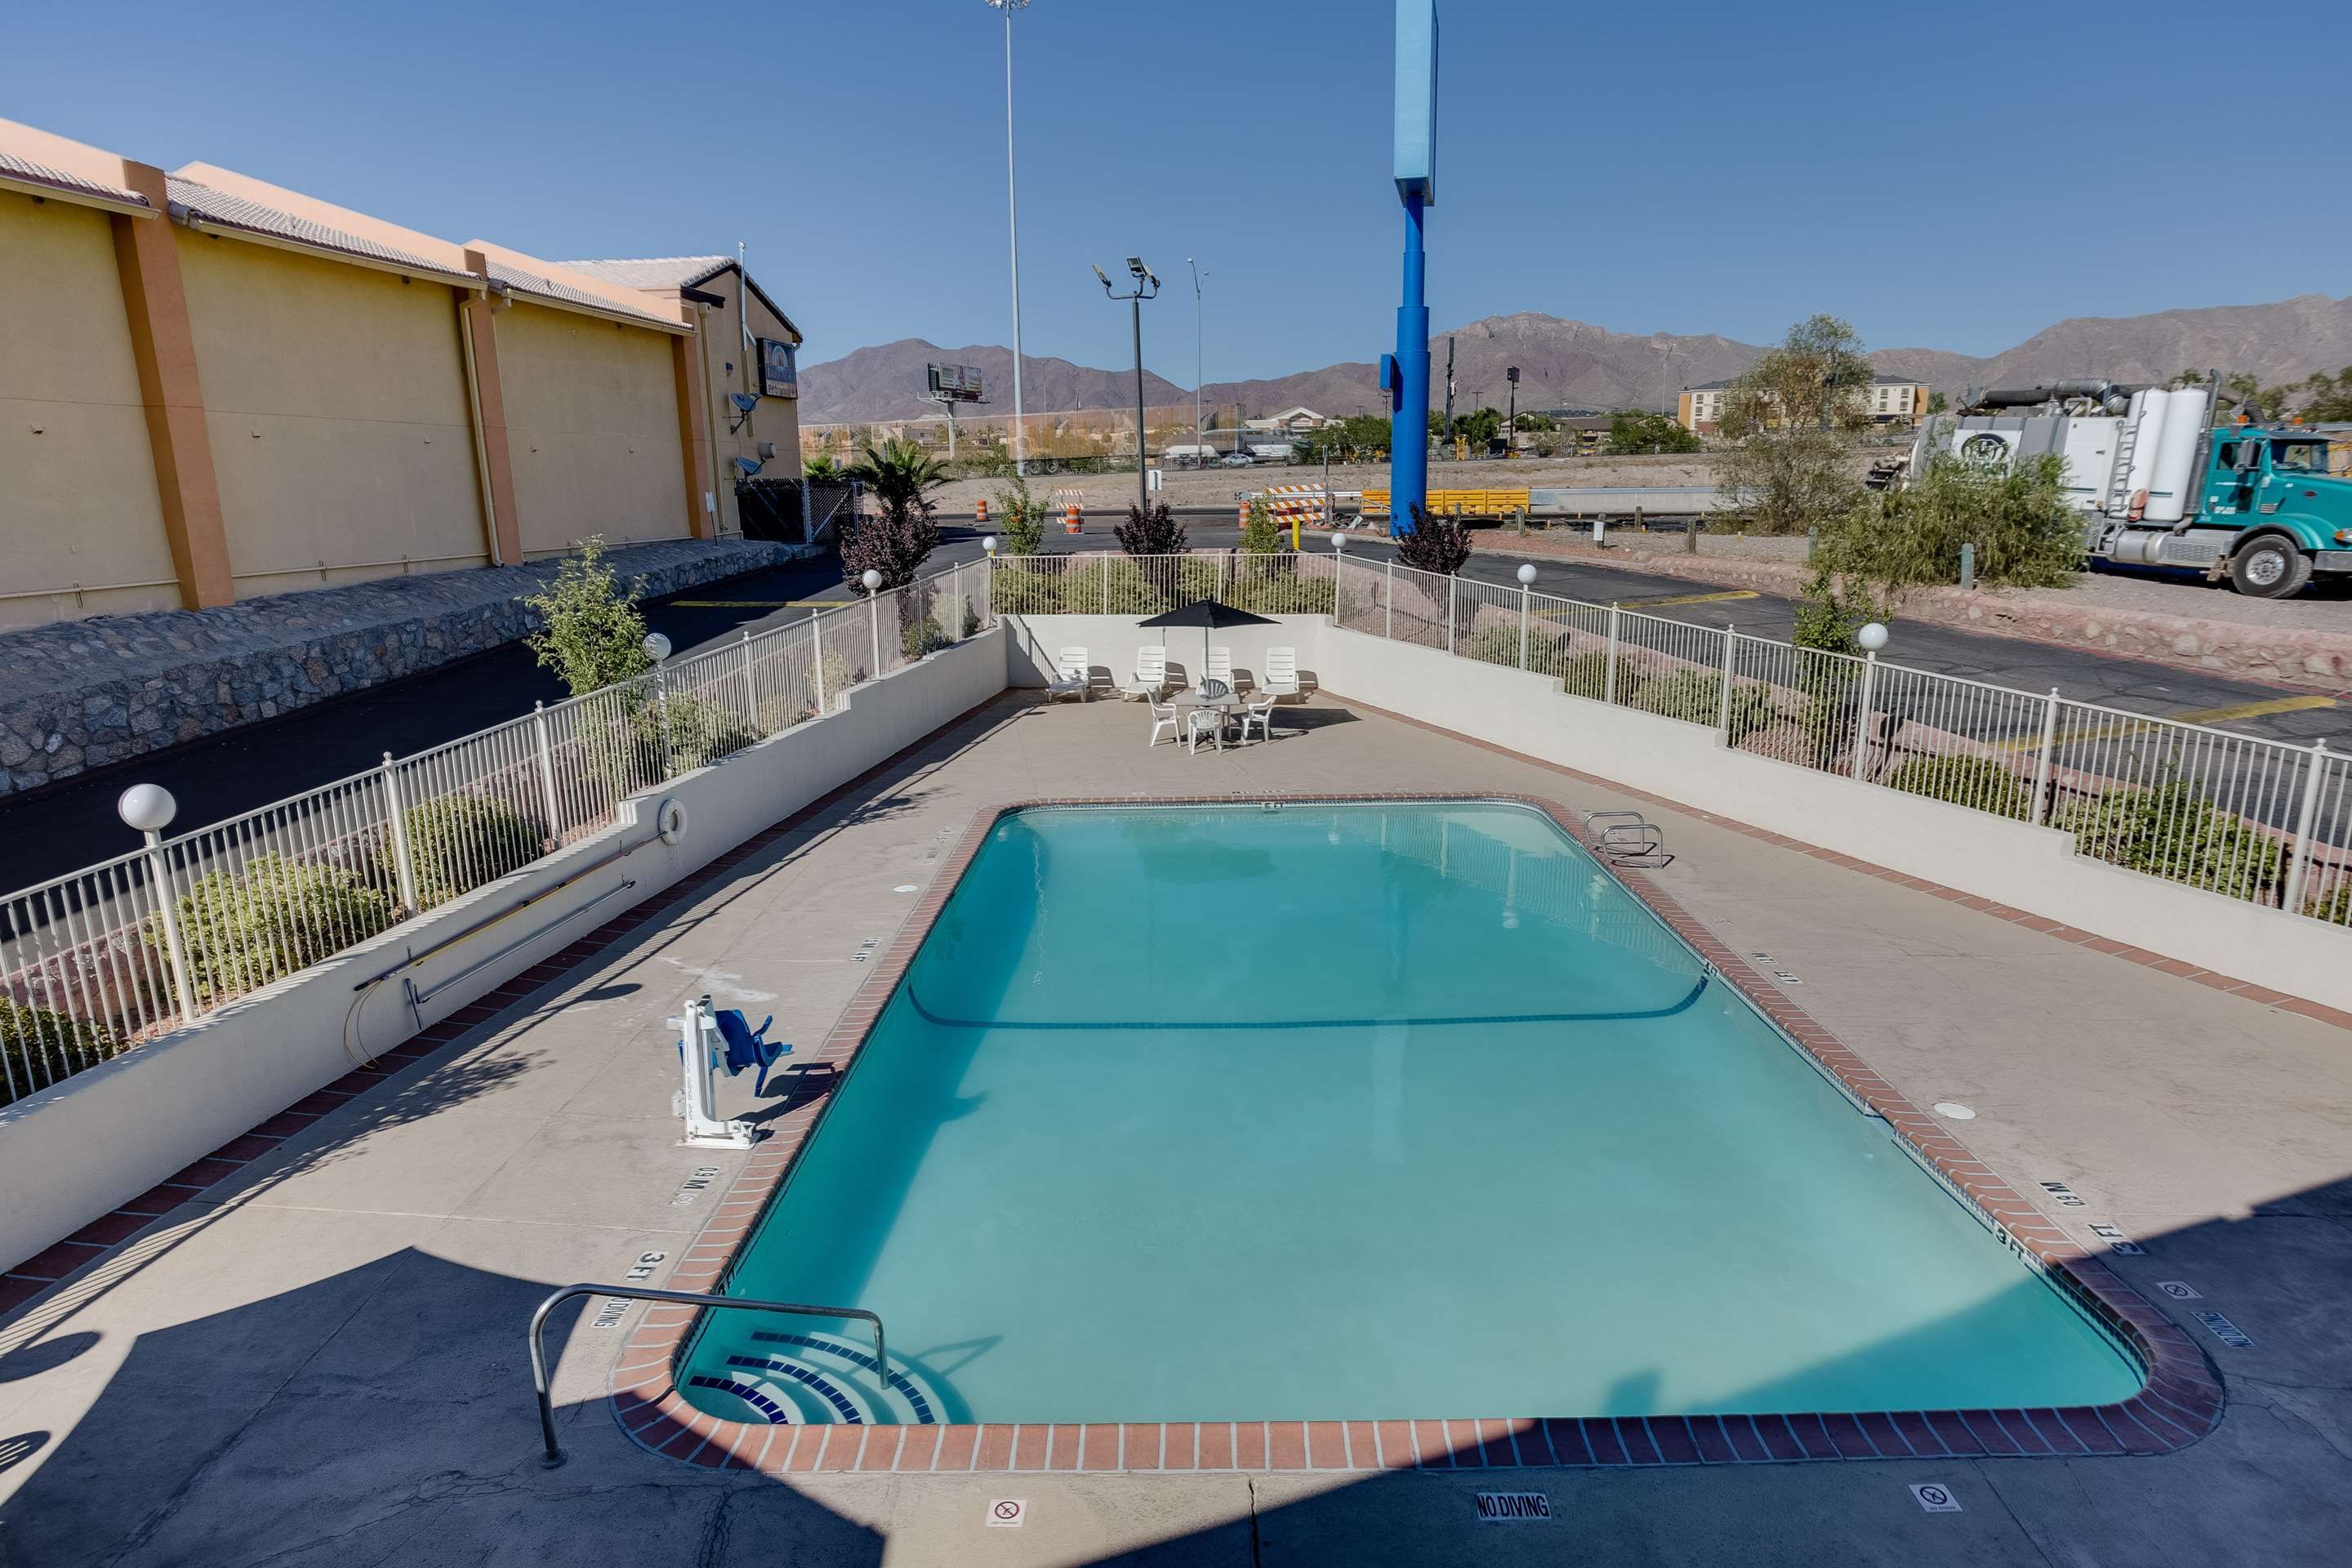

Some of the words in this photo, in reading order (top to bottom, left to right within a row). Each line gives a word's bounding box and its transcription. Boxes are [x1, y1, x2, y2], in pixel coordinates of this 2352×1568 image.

[2038, 1182, 2072, 1193] M
[1995, 1227, 2007, 1245] 3
[2110, 1241, 2140, 1253] 3
[639, 1253, 665, 1263] 3
[595, 1303, 629, 1327] DIVING
[1477, 1495, 1497, 1517] NO
[1498, 1495, 1550, 1517] DIVING
